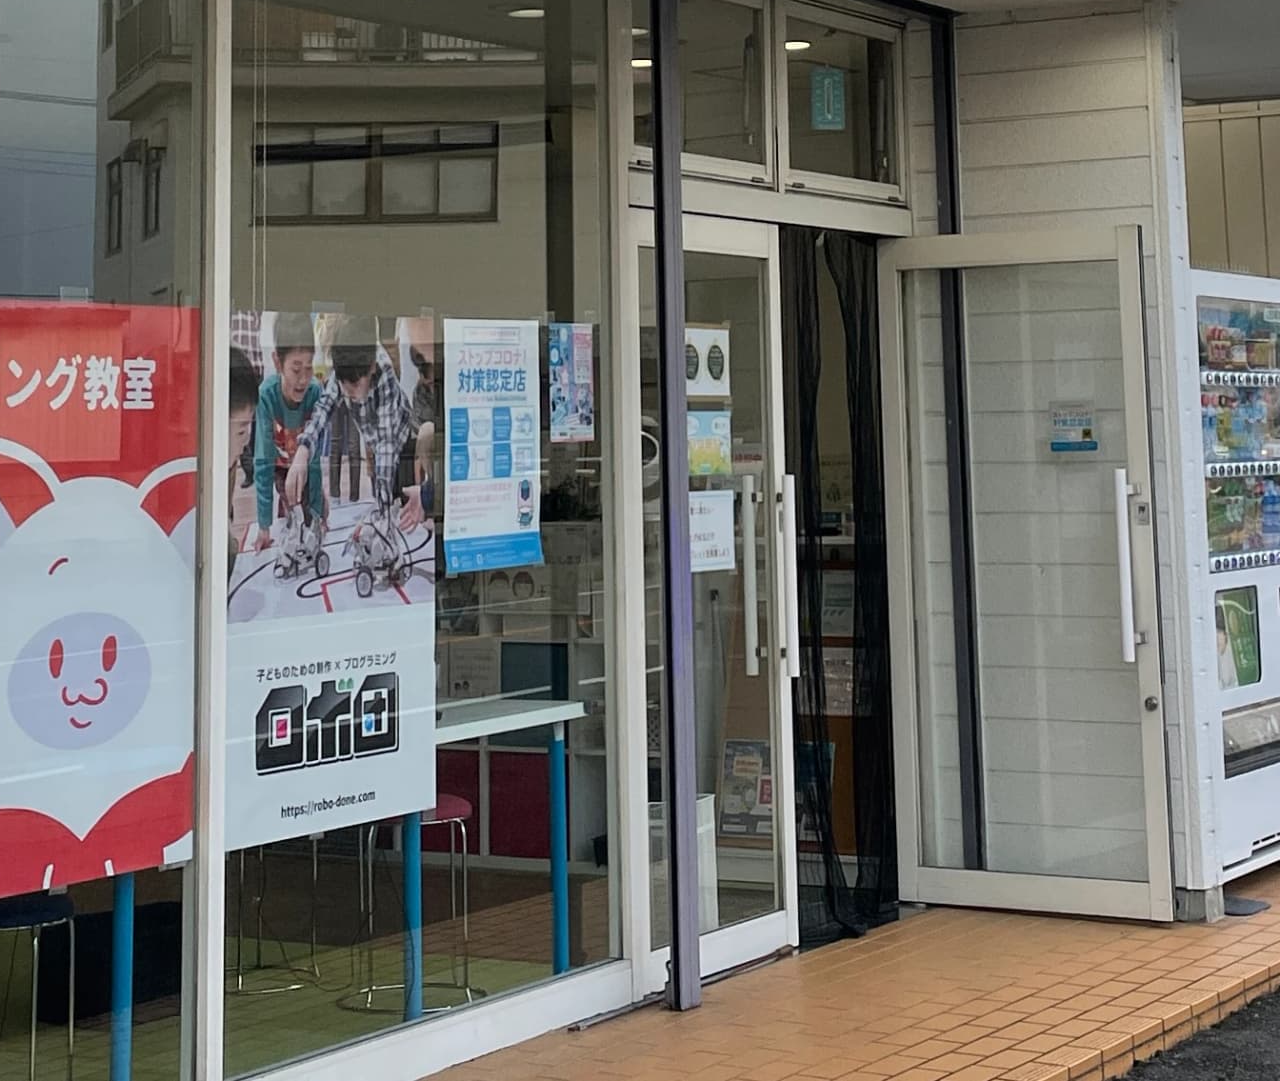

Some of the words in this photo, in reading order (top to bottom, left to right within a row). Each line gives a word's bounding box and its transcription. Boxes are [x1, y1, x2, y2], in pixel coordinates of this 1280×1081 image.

[458, 368, 527, 393] 対策認定店
[280, 791, 376, 819] https://robo-done.com
